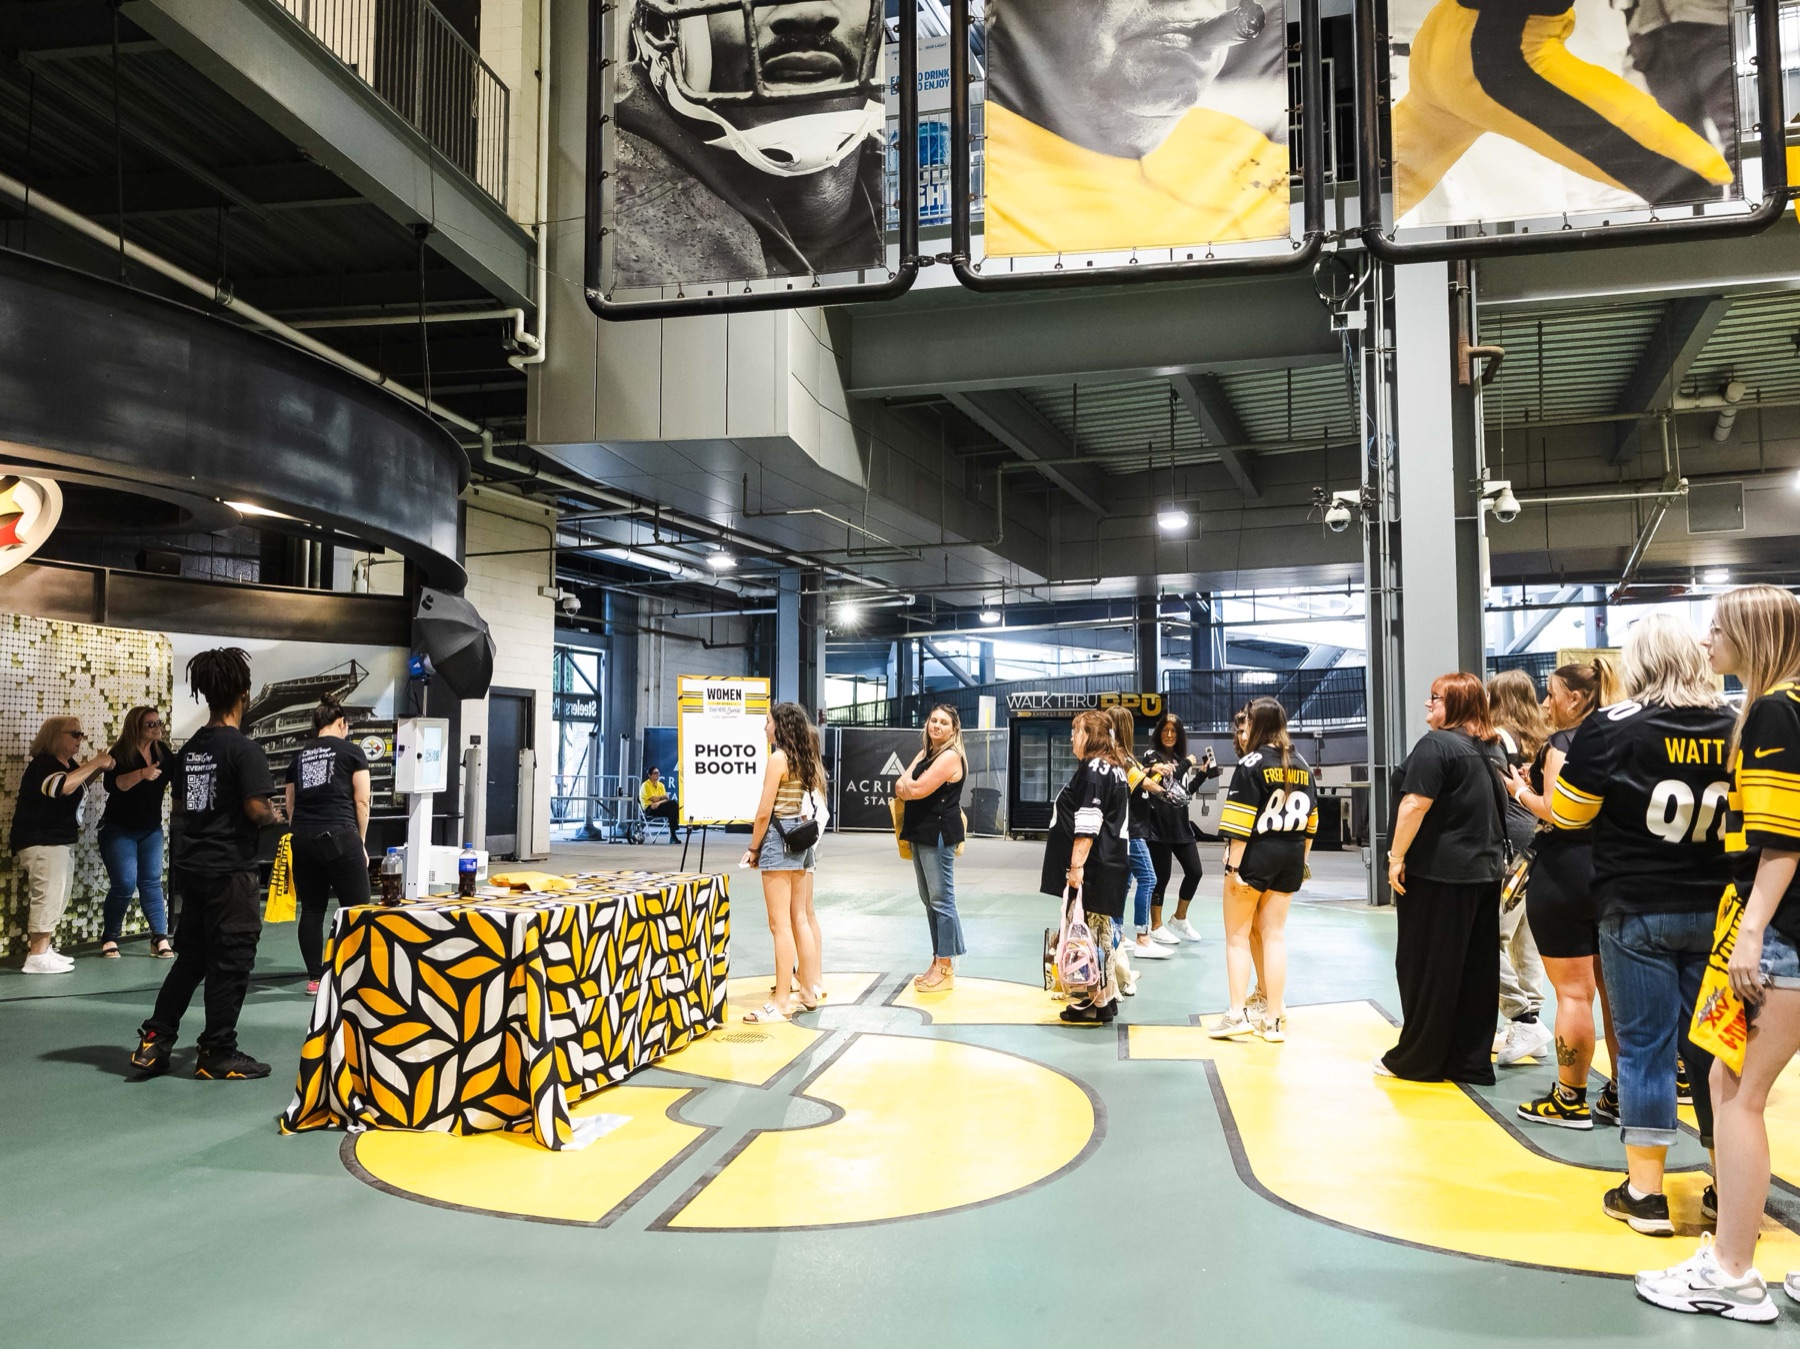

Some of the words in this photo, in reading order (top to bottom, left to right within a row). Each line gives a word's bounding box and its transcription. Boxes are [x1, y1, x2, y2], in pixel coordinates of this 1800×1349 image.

[924, 69, 950, 80] DRINK
[924, 79, 950, 90] ENJOY
[707, 688, 742, 701] WOMEN
[1006, 695, 1052, 709] WALK
[1054, 694, 1098, 708] THRU
[695, 744, 756, 757] PHOTO
[1665, 737, 1725, 764] WATT
[695, 761, 756, 774] BOOTH
[1088, 757, 1111, 776] 43
[1263, 767, 1309, 786] FREIEMUTH
[846, 779, 891, 793] ACRI
[1256, 788, 1310, 835] 88
